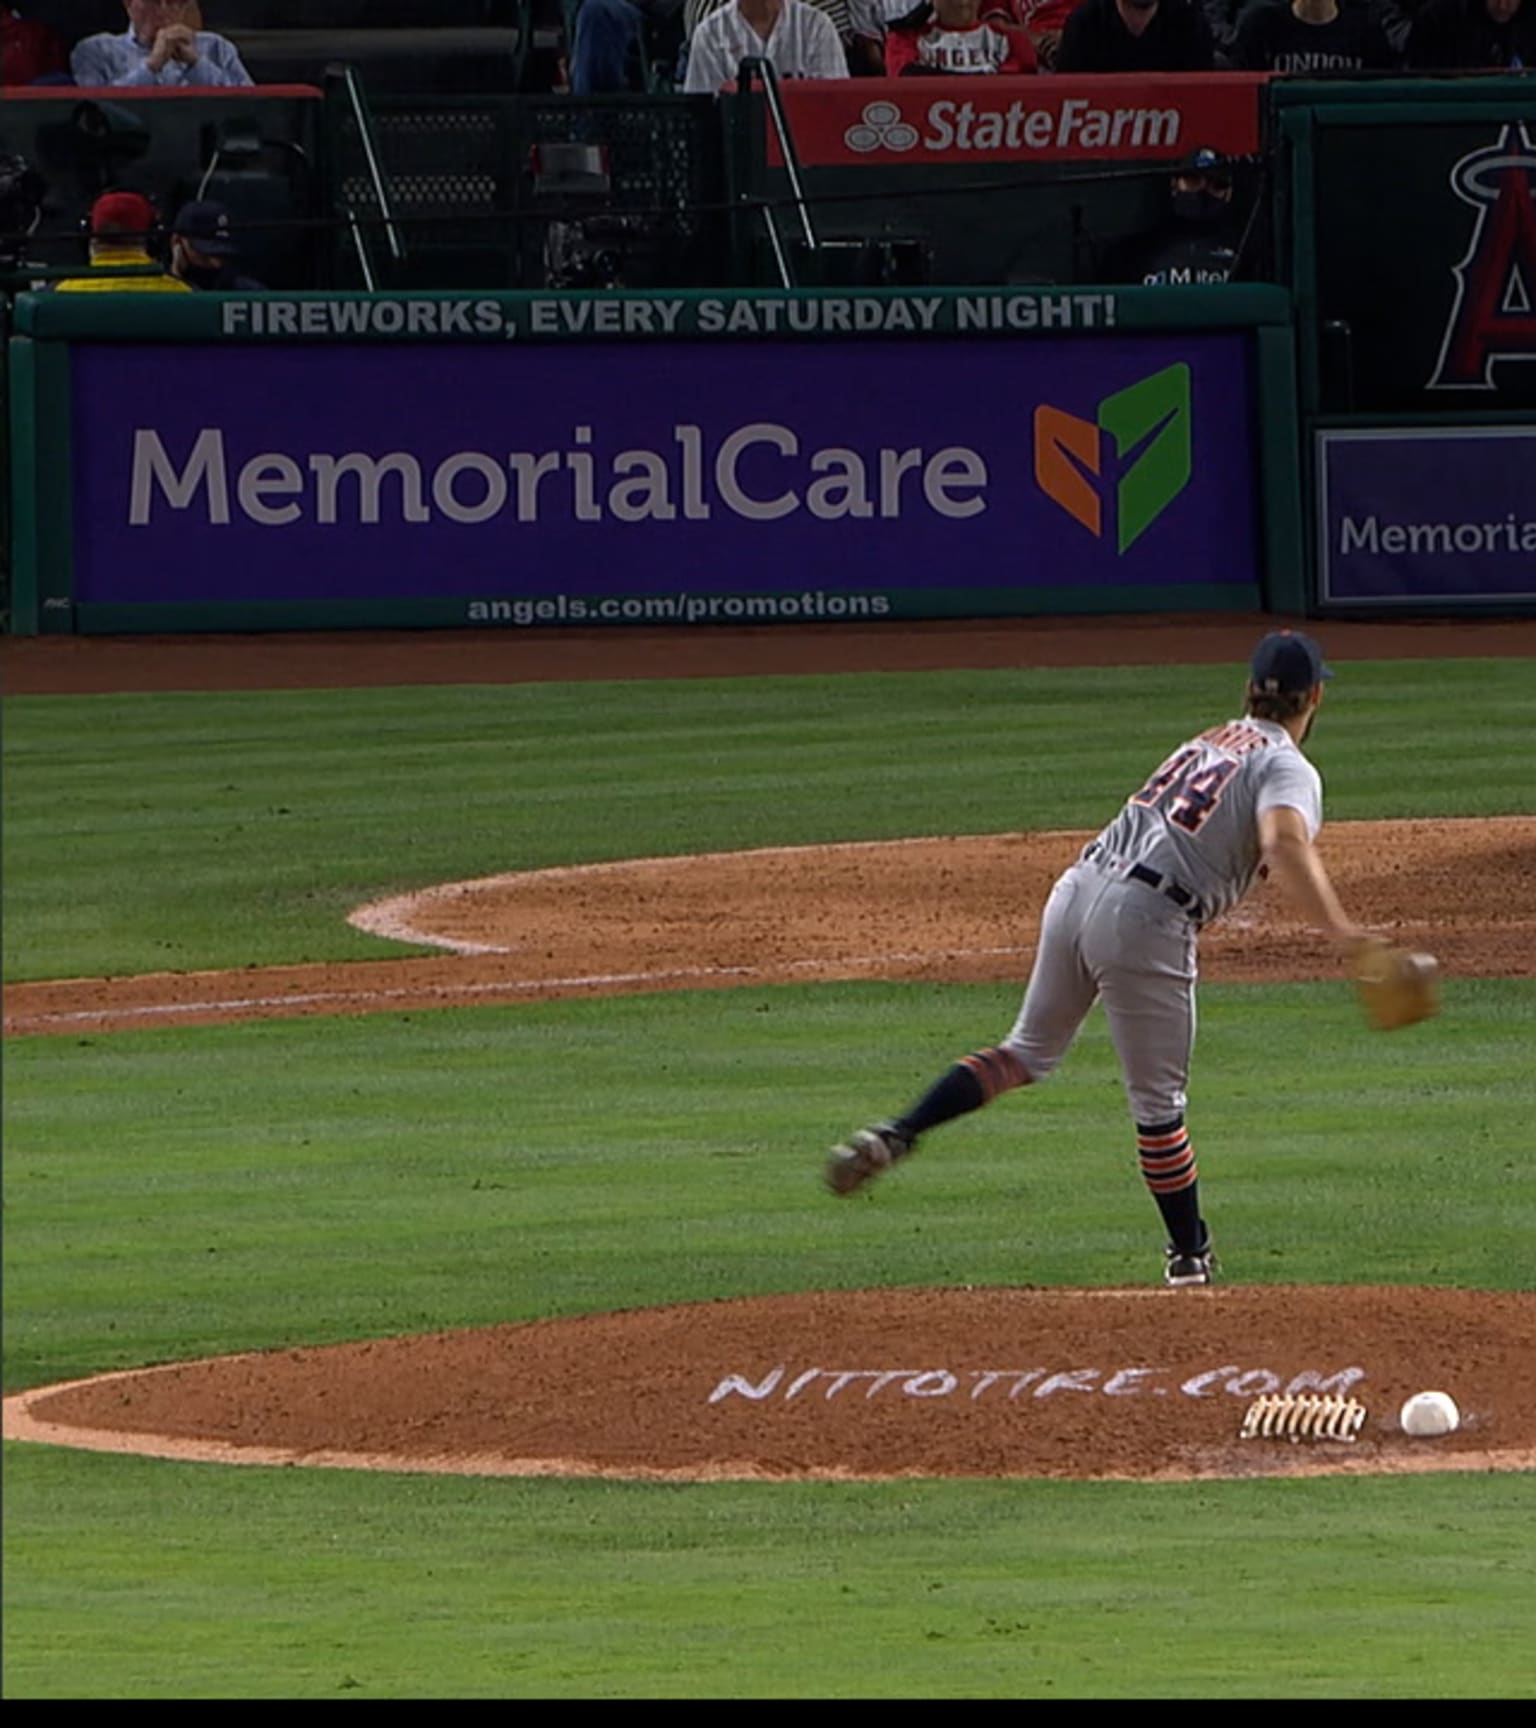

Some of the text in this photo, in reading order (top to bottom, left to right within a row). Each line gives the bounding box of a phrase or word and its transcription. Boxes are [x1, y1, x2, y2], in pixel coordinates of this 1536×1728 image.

[222, 294, 1115, 338] FIREWORKS, EVERY SATURDAY NIGHT!
[128, 423, 987, 525] MemorialCare
[468, 590, 890, 625] angels.com/promotions
